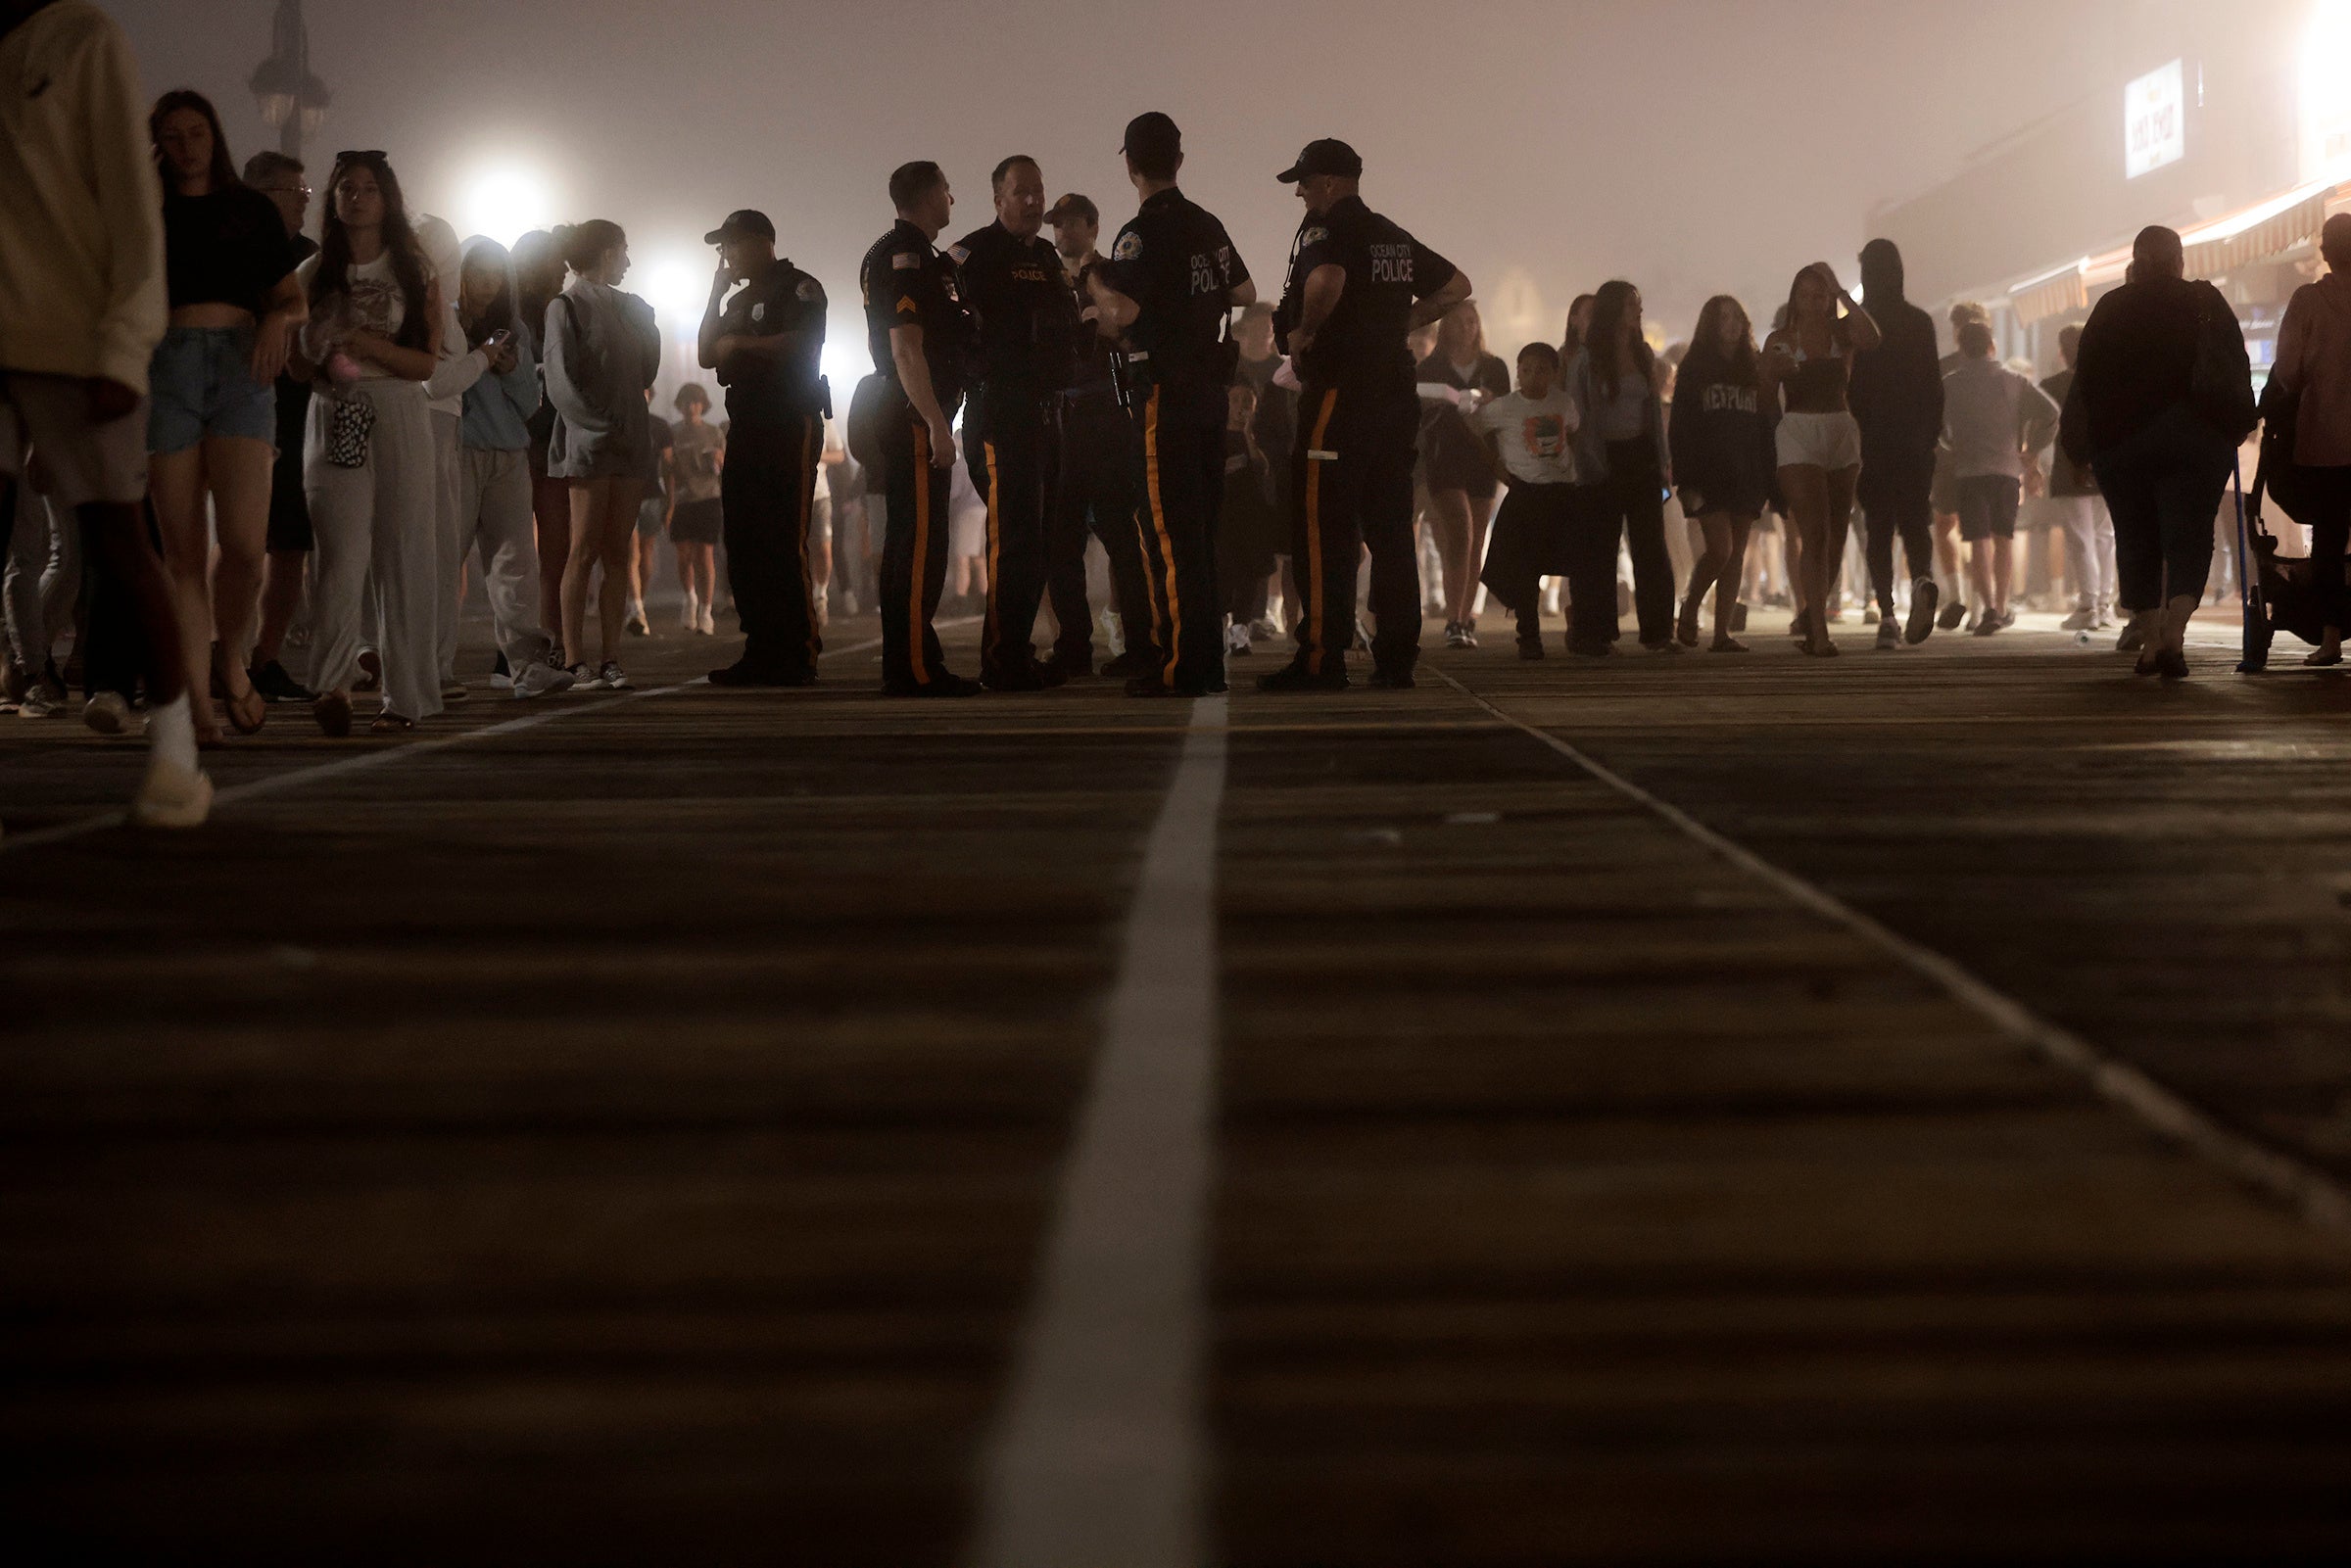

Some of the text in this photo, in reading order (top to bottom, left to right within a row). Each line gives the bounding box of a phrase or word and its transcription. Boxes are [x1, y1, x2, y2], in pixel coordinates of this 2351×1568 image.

[1369, 244, 1396, 259] OCEAN
[1011, 268, 1048, 282] POLICE
[1371, 259, 1414, 282] POLICE
